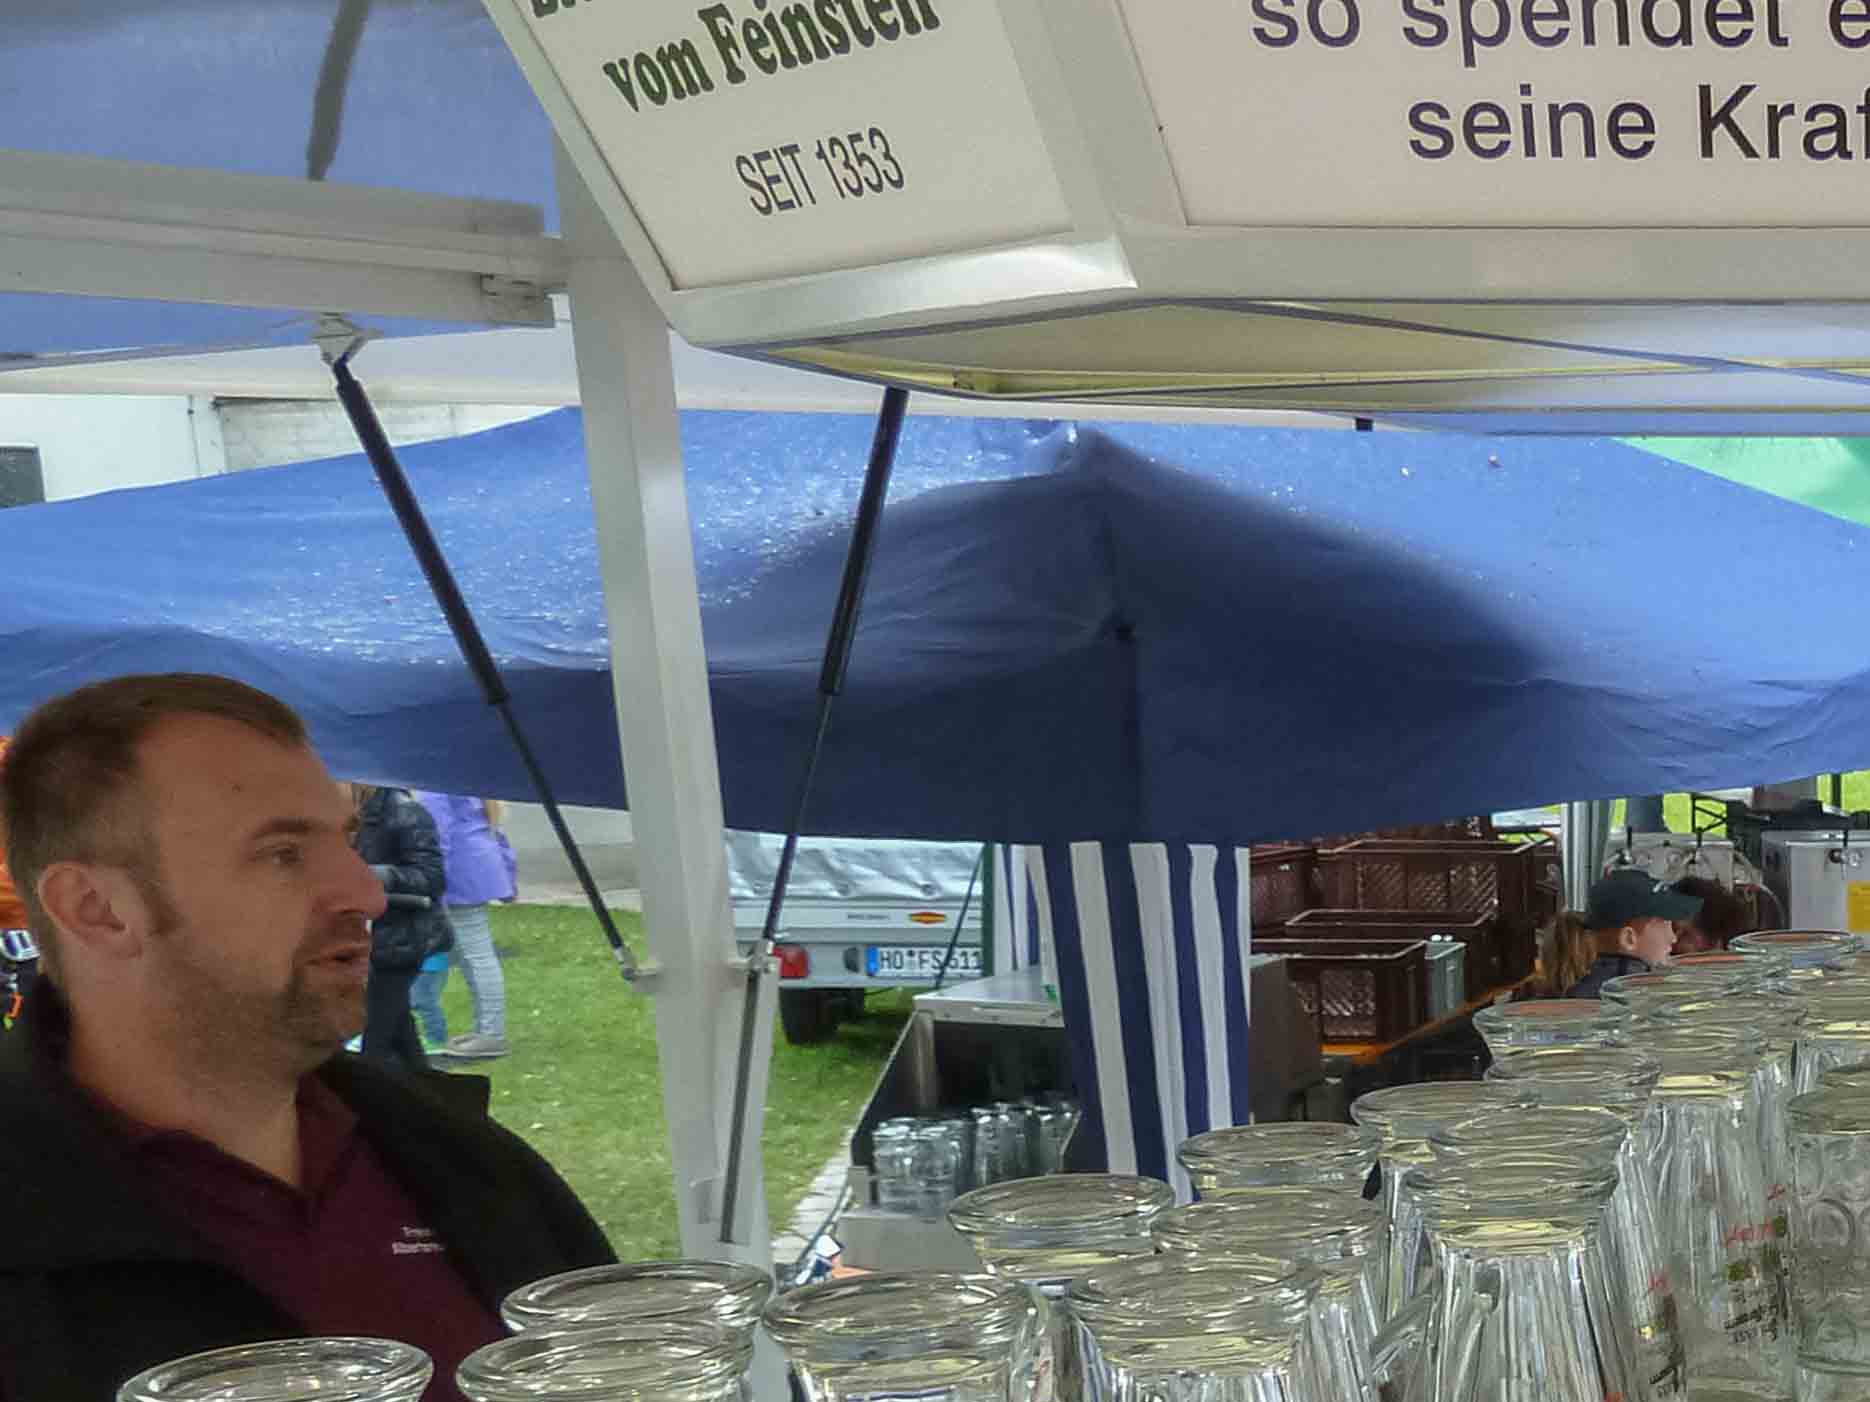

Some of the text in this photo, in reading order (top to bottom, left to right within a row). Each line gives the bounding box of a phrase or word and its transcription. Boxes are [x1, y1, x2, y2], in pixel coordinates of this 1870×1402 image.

[602, 0, 940, 113] vom Feinsten
[1252, 0, 1361, 47] so
[1402, 0, 1789, 68] spendet
[1407, 83, 1657, 160] seine
[735, 127, 904, 216] SEIT 1353
[880, 950, 905, 970] HO
[919, 950, 945, 970] FS
